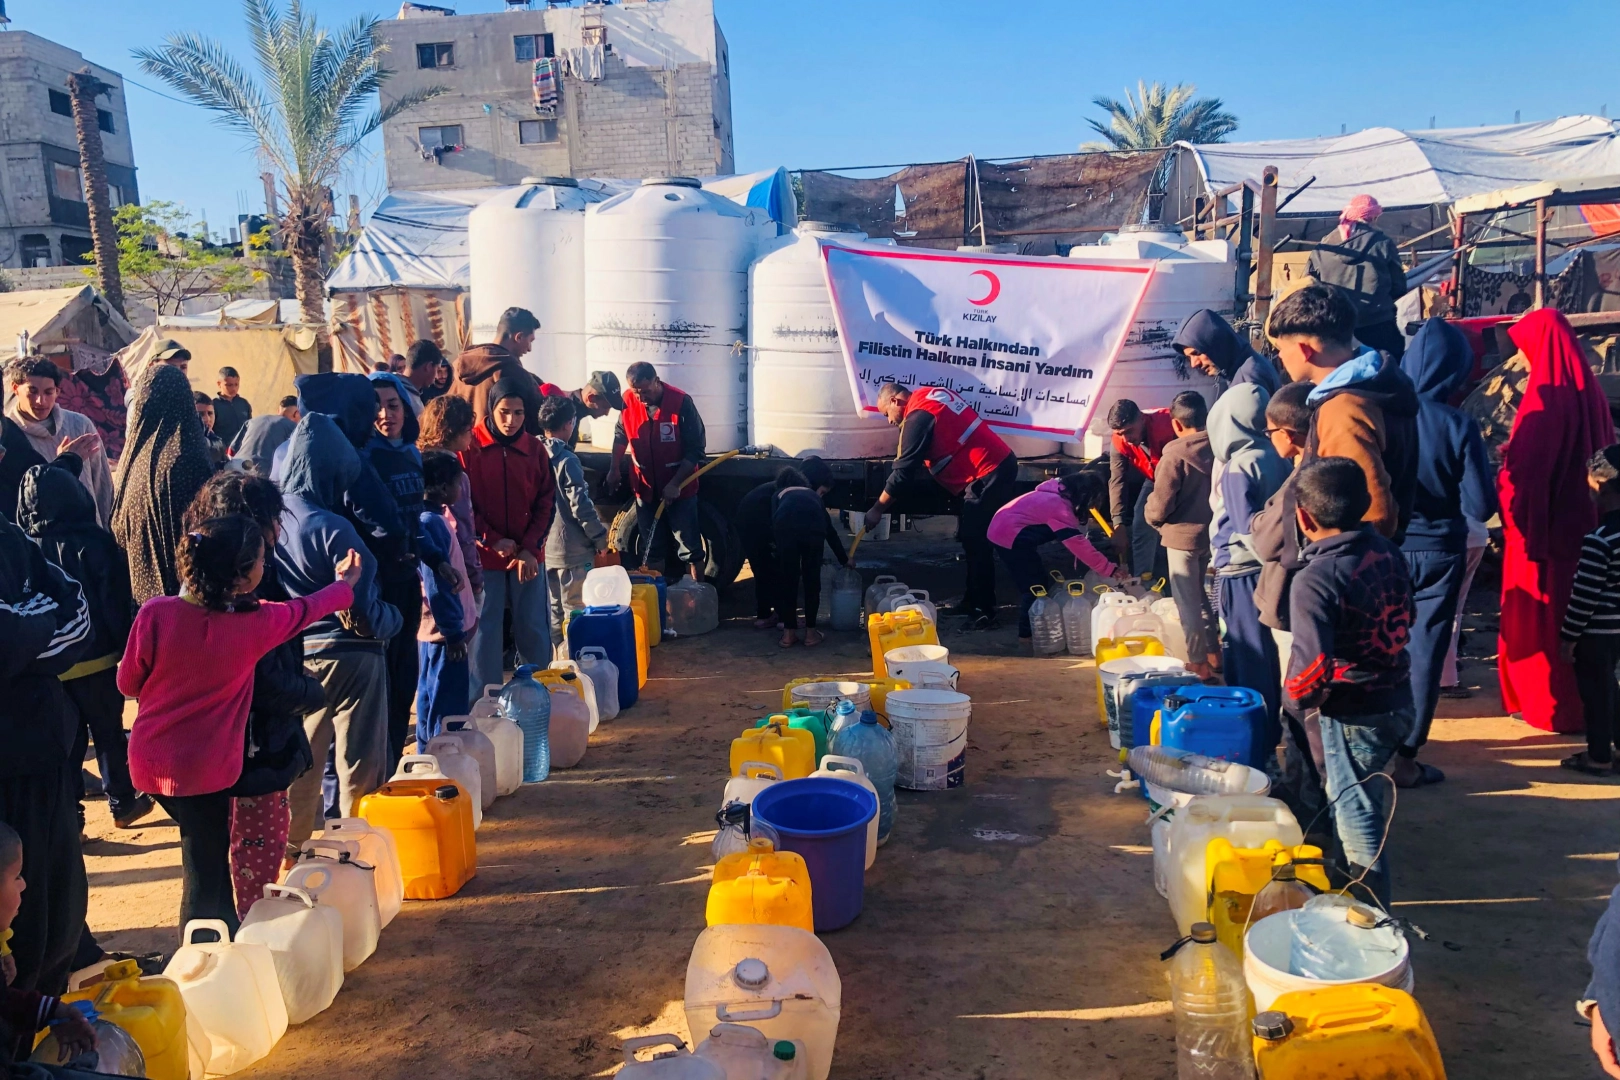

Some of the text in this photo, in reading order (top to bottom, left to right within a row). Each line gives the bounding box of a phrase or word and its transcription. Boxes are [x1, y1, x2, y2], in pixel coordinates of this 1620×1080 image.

[962, 313, 997, 323] KIZILAY
[915, 330, 1040, 356] Türk Halkından
[858, 341, 1093, 379] Filistin Halkına İnsani Yardım
[956, 383, 974, 393] من
[979, 383, 1032, 402] الإنسانية
[984, 405, 1019, 417] الشعب
